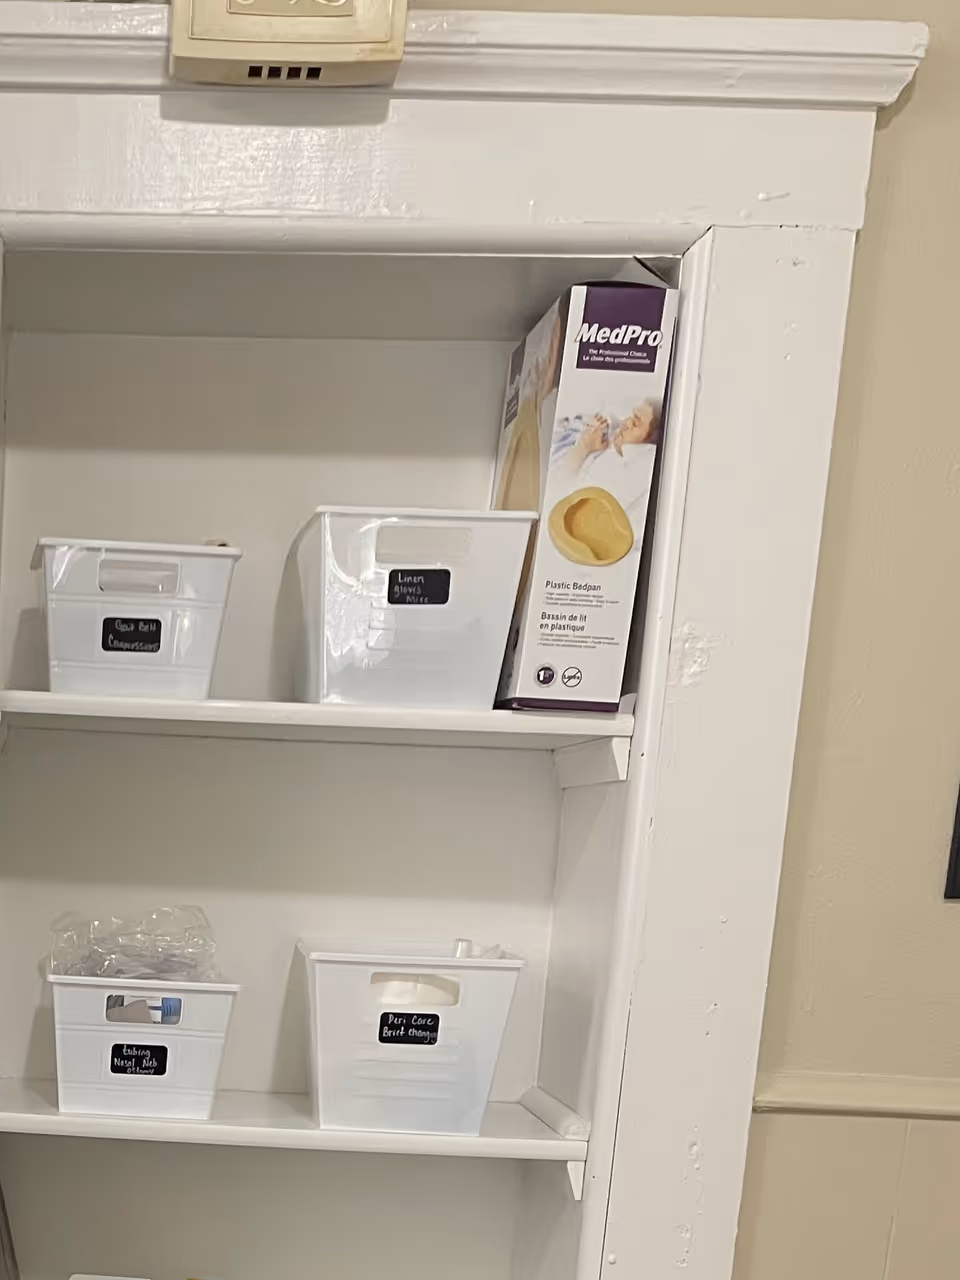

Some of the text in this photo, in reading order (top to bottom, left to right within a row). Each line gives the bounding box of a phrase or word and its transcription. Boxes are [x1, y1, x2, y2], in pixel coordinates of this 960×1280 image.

[575, 323, 662, 347] MedPro
[398, 571, 424, 584] Linen
[545, 580, 601, 592] Plastic Bedpan
[541, 611, 587, 622] Bassin de lit
[550, 622, 585, 632] plastique
[388, 1014, 434, 1025] Peri Care
[114, 1057, 158, 1068] Nasal Neb
